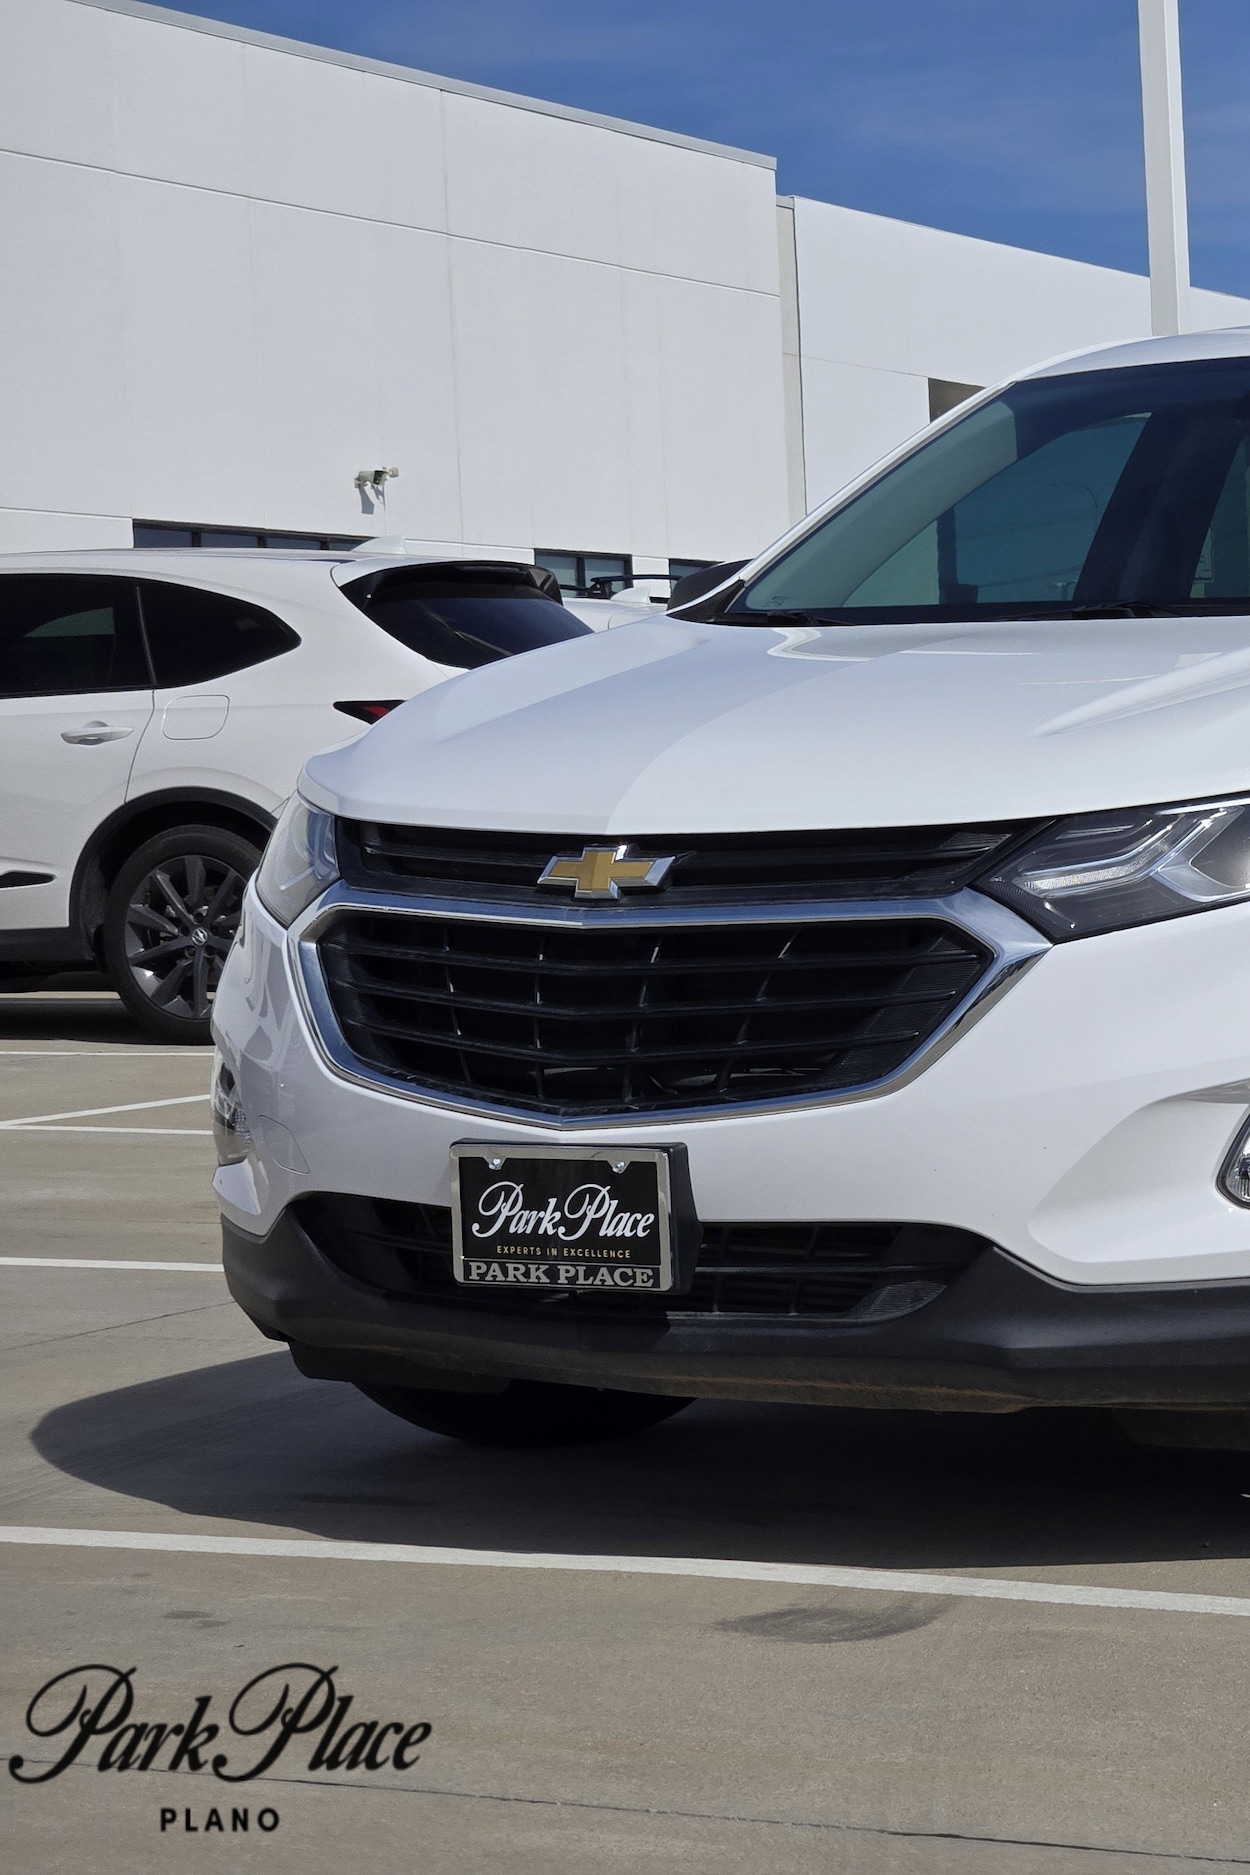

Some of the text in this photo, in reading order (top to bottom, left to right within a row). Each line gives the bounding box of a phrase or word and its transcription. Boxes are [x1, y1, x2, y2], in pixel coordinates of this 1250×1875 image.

[471, 1180, 656, 1241] Park Place
[496, 1245, 632, 1260] EXPERTS IN EXCELLENCE
[468, 1261, 655, 1288] PARK PLACE
